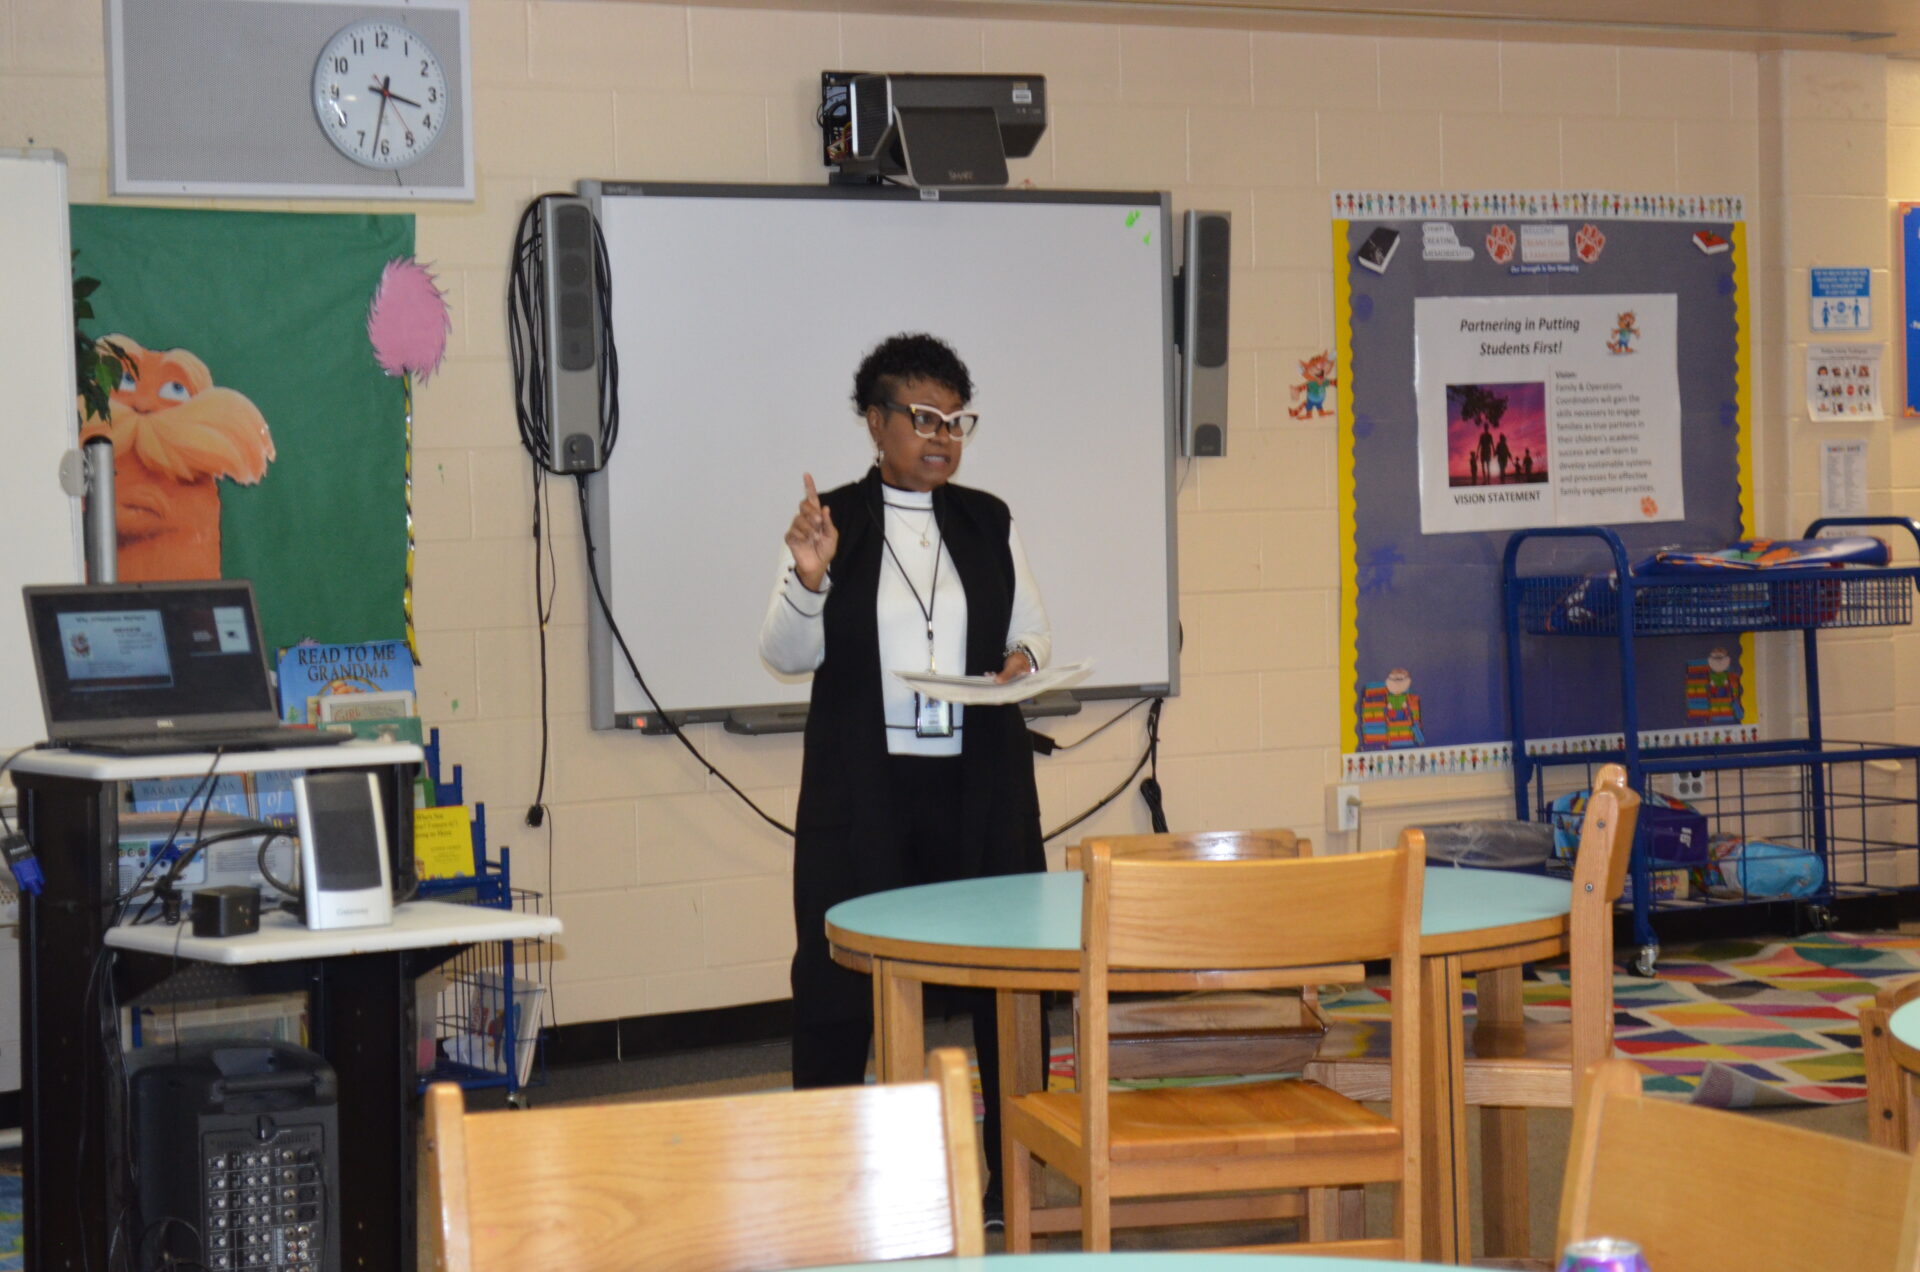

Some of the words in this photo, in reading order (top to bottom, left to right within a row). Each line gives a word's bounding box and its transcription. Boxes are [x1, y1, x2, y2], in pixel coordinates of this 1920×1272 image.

[353, 38, 364, 55] 11
[375, 32, 389, 48] 12
[334, 58, 349, 73] 10
[421, 60, 429, 77] 2
[330, 84, 340, 99] 9
[428, 87, 437, 102] 3
[422, 114, 431, 130] 4
[357, 130, 366, 148] 7
[405, 131, 414, 147] 5
[381, 140, 389, 155] 6
[1460, 318, 1522, 334] Partnering
[1525, 317, 1536, 331] in
[1539, 316, 1580, 333] Putting
[1480, 341, 1530, 356] Students
[1533, 339, 1562, 354] First!
[1556, 383, 1577, 392] Family
[1579, 383, 1584, 391] &
[1586, 382, 1623, 391] Operations
[1556, 396, 1599, 405] Coordinators
[1601, 395, 1611, 403] will
[1613, 395, 1627, 404] gain
[1629, 394, 1640, 402] the
[1556, 409, 1572, 417] skills
[1574, 409, 1606, 418] necessary
[1608, 408, 1615, 416] to
[1616, 408, 1640, 417] engage
[1557, 423, 1583, 431] families
[1594, 422, 1607, 430] true
[1609, 421, 1636, 430] partners
[1558, 436, 1573, 444] their
[1609, 433, 1640, 441] academic
[1585, 447, 1598, 456] and
[1600, 447, 1611, 455] will
[1612, 446, 1629, 454] learn
[1631, 445, 1638, 453] to
[1559, 461, 1586, 471] develop
[1588, 460, 1624, 468] sustainable
[1626, 459, 1652, 468] systems
[1560, 474, 1573, 483] and
[1574, 473, 1607, 483] processes
[1608, 472, 1617, 480] for
[1619, 471, 1648, 480] effective
[1454, 493, 1486, 506] VISION
[1488, 490, 1541, 504] STATEMENT
[1560, 487, 1581, 496] family
[1583, 486, 1623, 496] engagement
[297, 647, 341, 665] READ
[344, 645, 367, 662] TO
[373, 644, 396, 660] ME
[307, 662, 390, 681] GRANDMA
[156, 719, 175, 729] DELL
[141, 784, 187, 796] BARACK
